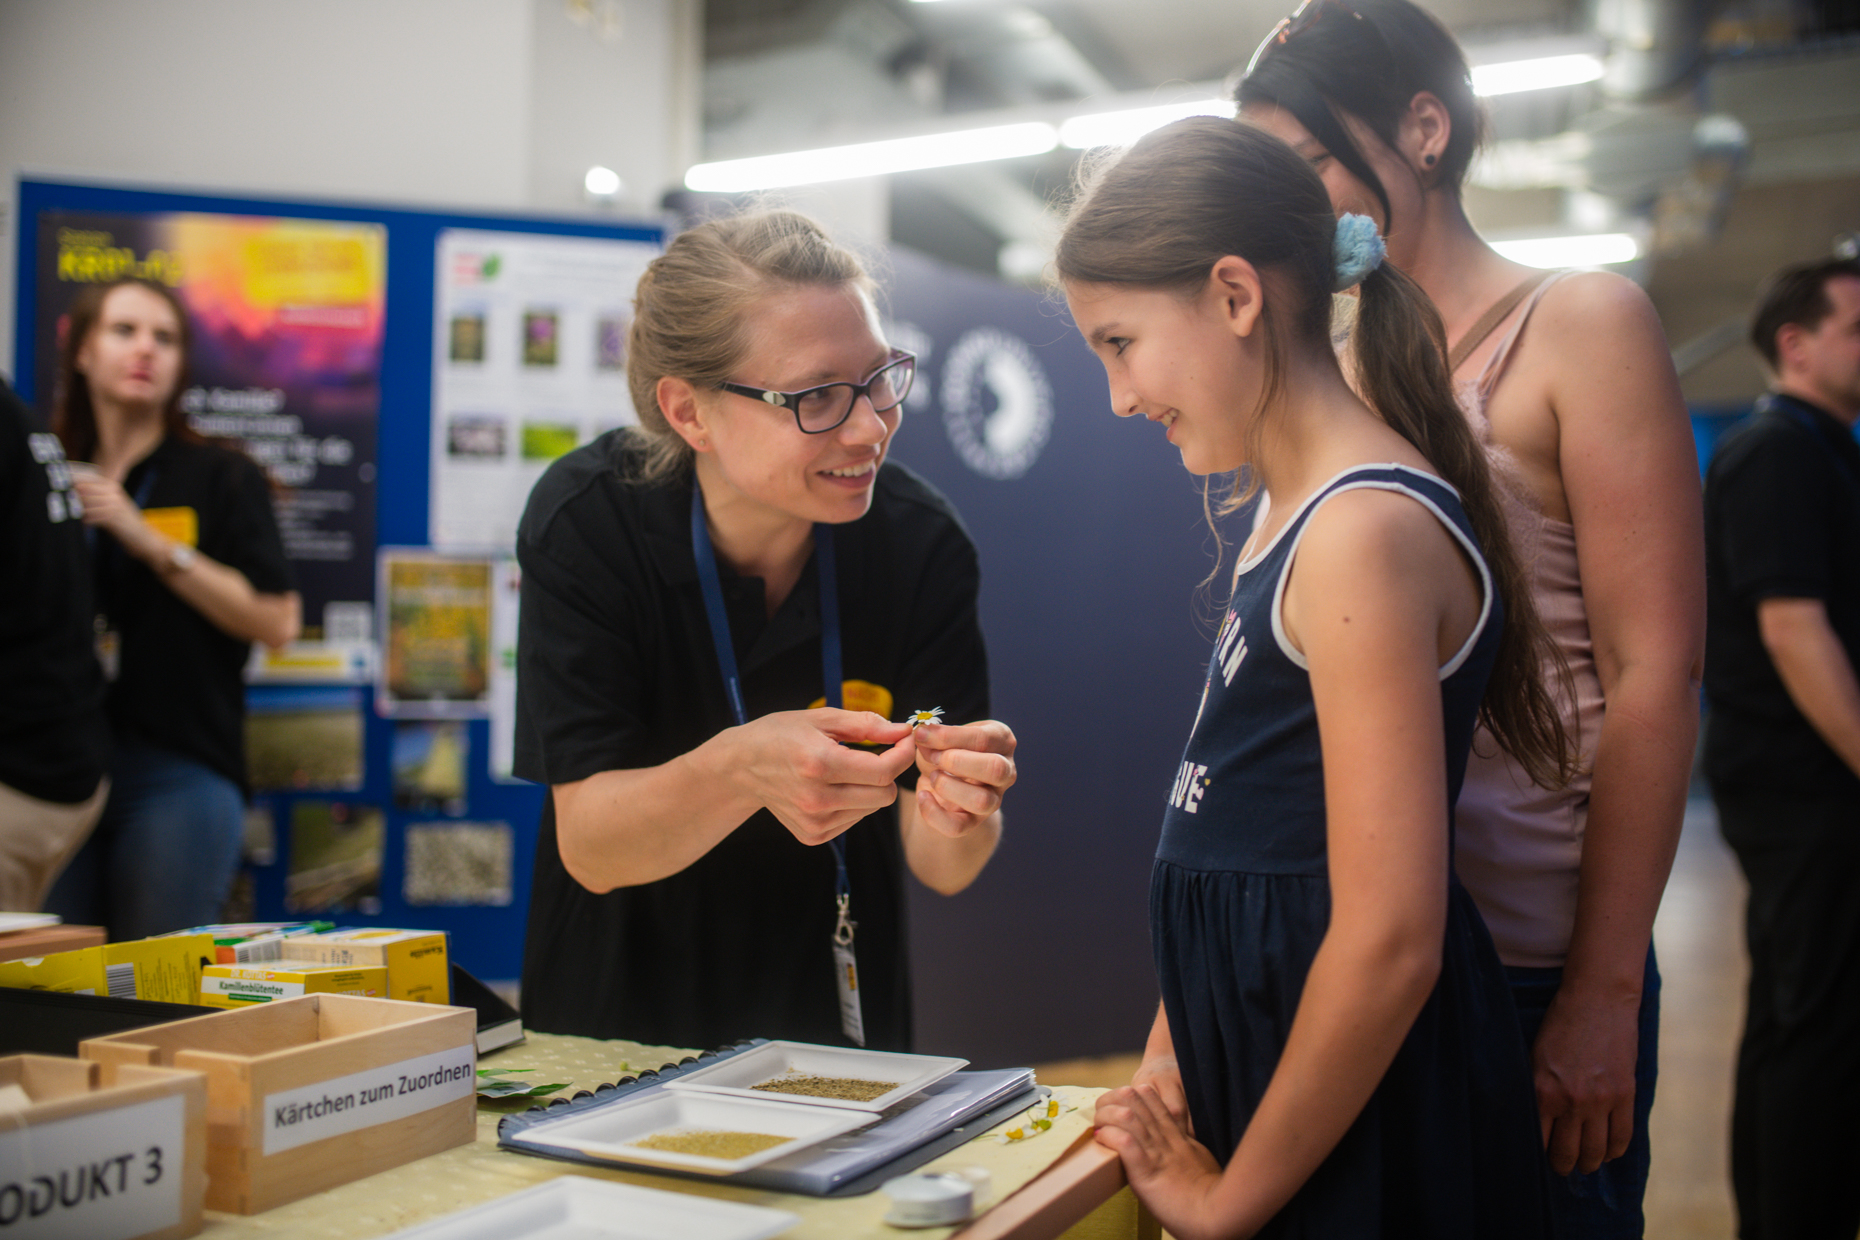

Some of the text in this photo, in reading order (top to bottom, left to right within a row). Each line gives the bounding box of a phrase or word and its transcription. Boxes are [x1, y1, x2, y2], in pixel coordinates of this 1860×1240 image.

[219, 980, 284, 995] Kamillenblütentee
[242, 971, 267, 980] KOTTAS
[274, 1063, 471, 1128] Kärtchen zum Zuordnen
[143, 1146, 163, 1185] 3
